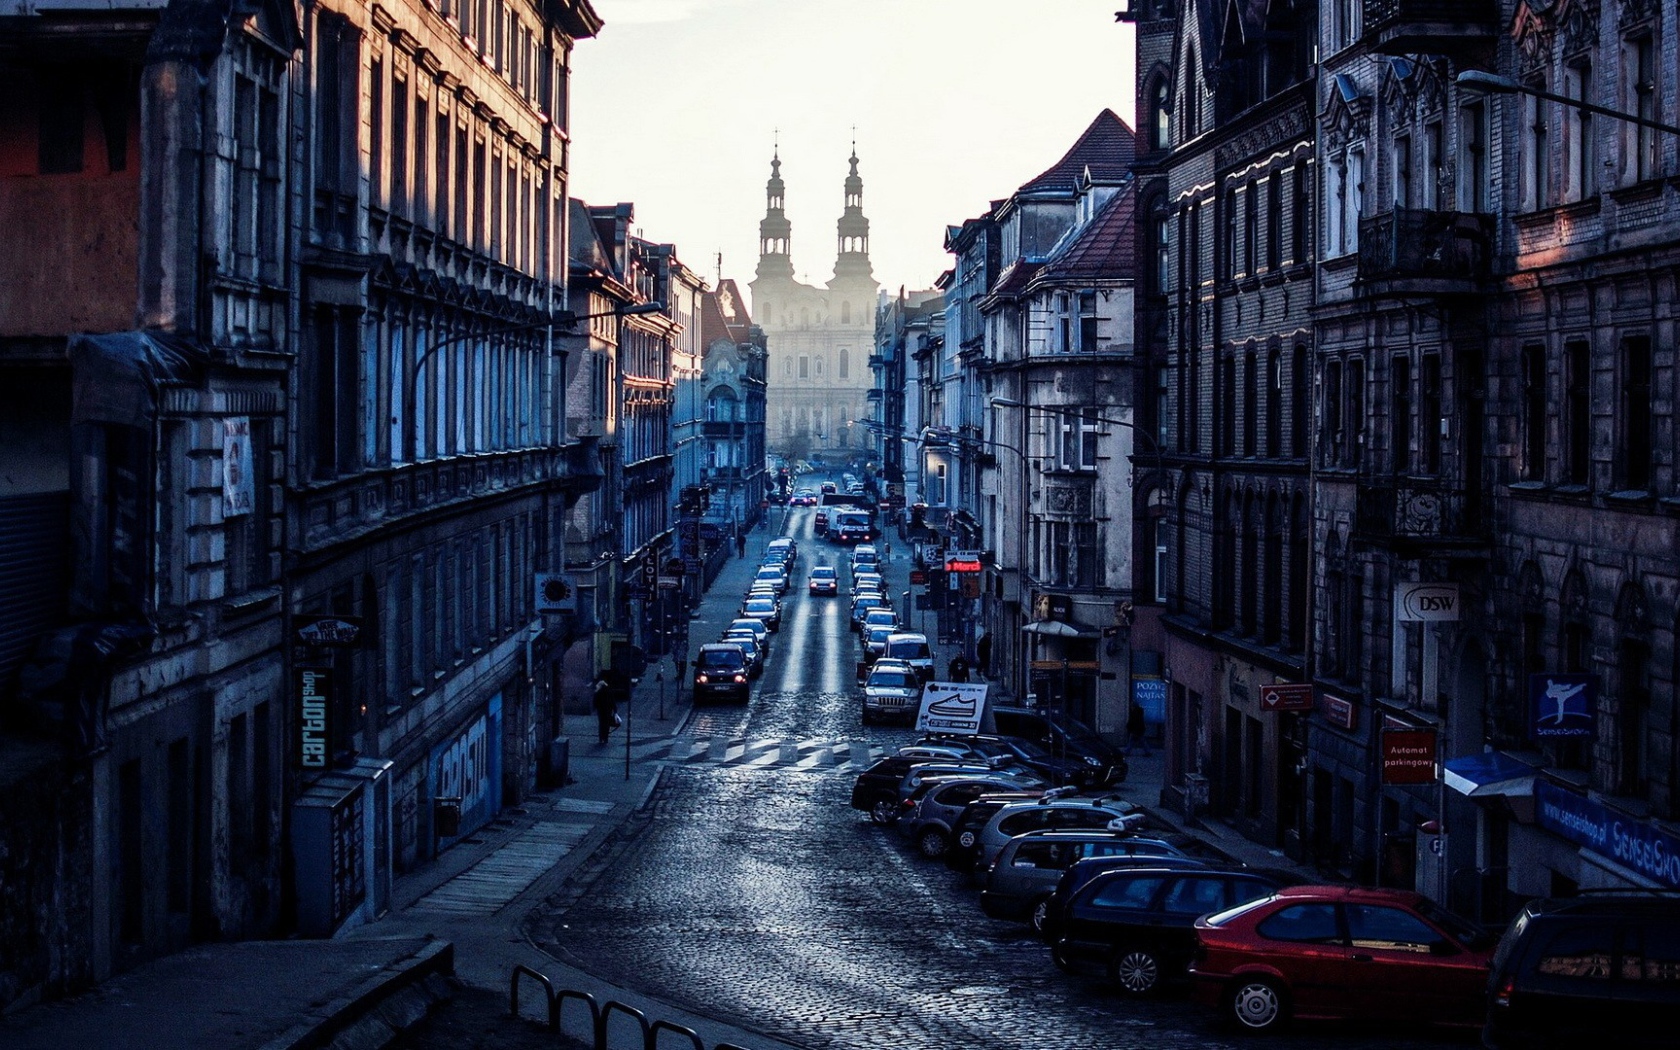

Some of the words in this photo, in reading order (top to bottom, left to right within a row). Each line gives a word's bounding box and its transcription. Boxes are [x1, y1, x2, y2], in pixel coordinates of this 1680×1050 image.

[1419, 596, 1456, 611] DSW
[1390, 746, 1427, 754] Automat
[1384, 758, 1433, 768] parkingowy
